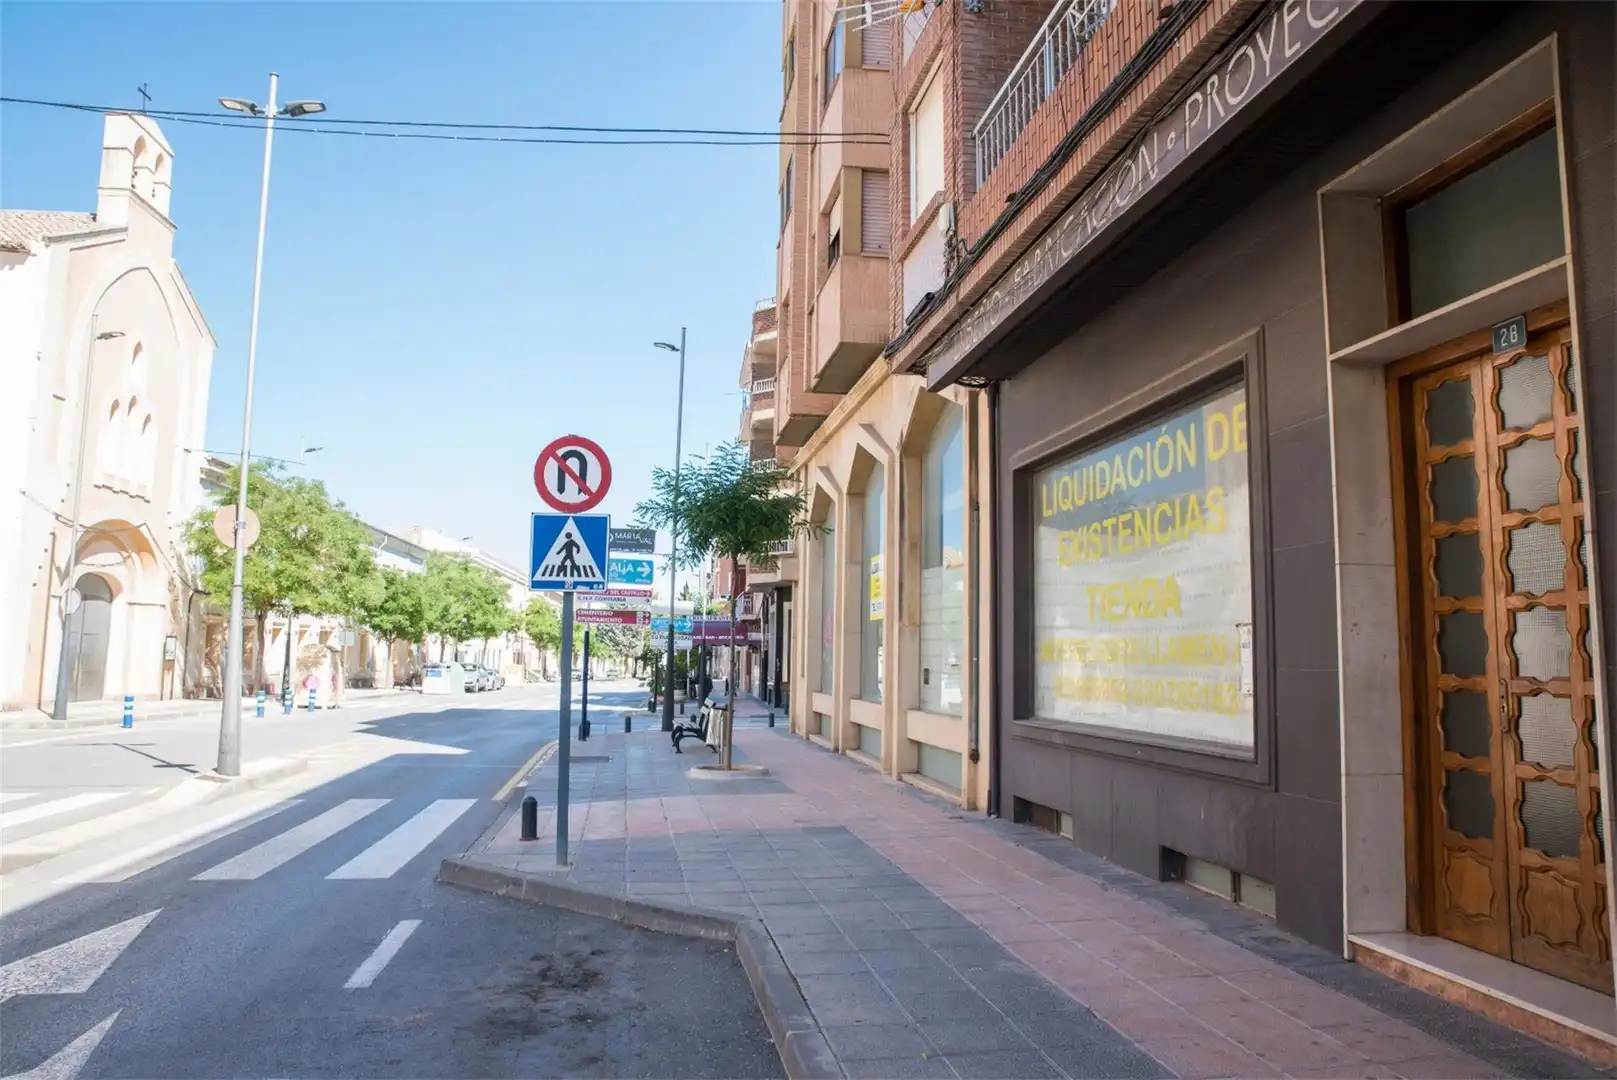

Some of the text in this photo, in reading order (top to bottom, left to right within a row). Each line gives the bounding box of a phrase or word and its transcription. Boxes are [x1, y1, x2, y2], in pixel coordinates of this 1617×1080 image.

[1500, 324, 1517, 347] 28
[1041, 402, 1247, 517] LIQUIDACIÓN DE
[1057, 487, 1228, 567] EXISTENCIAS
[1085, 575, 1183, 622] TIENDA
[1146, 633, 1227, 667] LLAMEN
